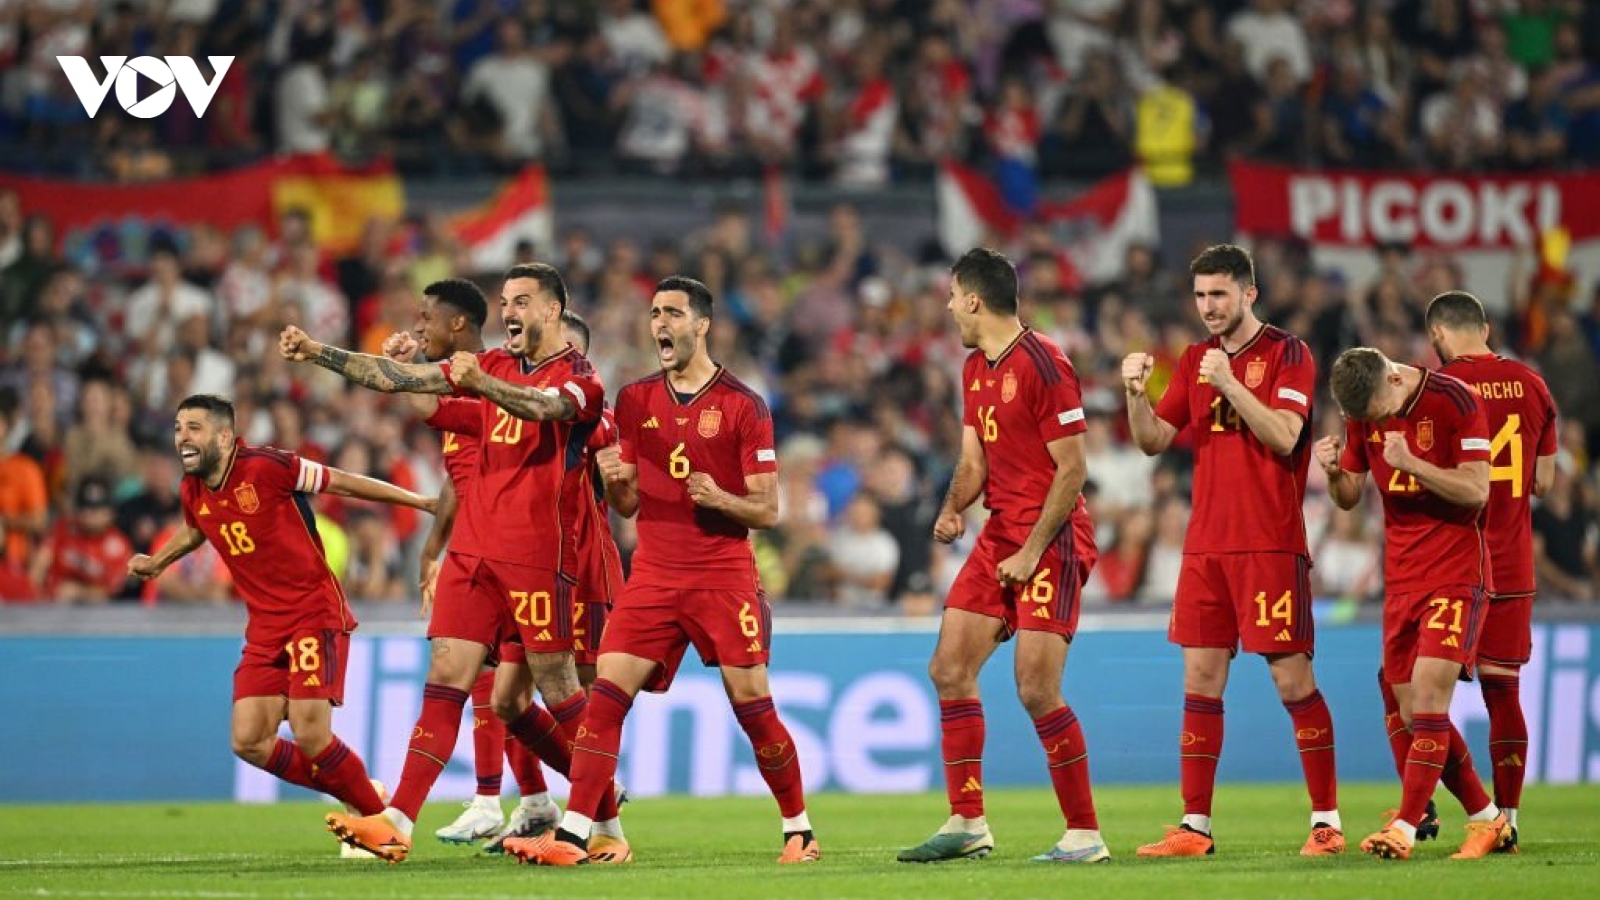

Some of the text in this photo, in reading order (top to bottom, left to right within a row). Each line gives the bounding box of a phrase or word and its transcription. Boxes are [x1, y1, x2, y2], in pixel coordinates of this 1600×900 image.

[490, 406, 523, 444] 20
[669, 442, 690, 479] 6
[1488, 414, 1522, 498] 4
[219, 521, 256, 556] 18
[509, 591, 551, 626] 20
[738, 602, 759, 637] 6
[1254, 590, 1292, 626] 14
[1427, 597, 1463, 633] 21
[285, 637, 320, 673] 18
